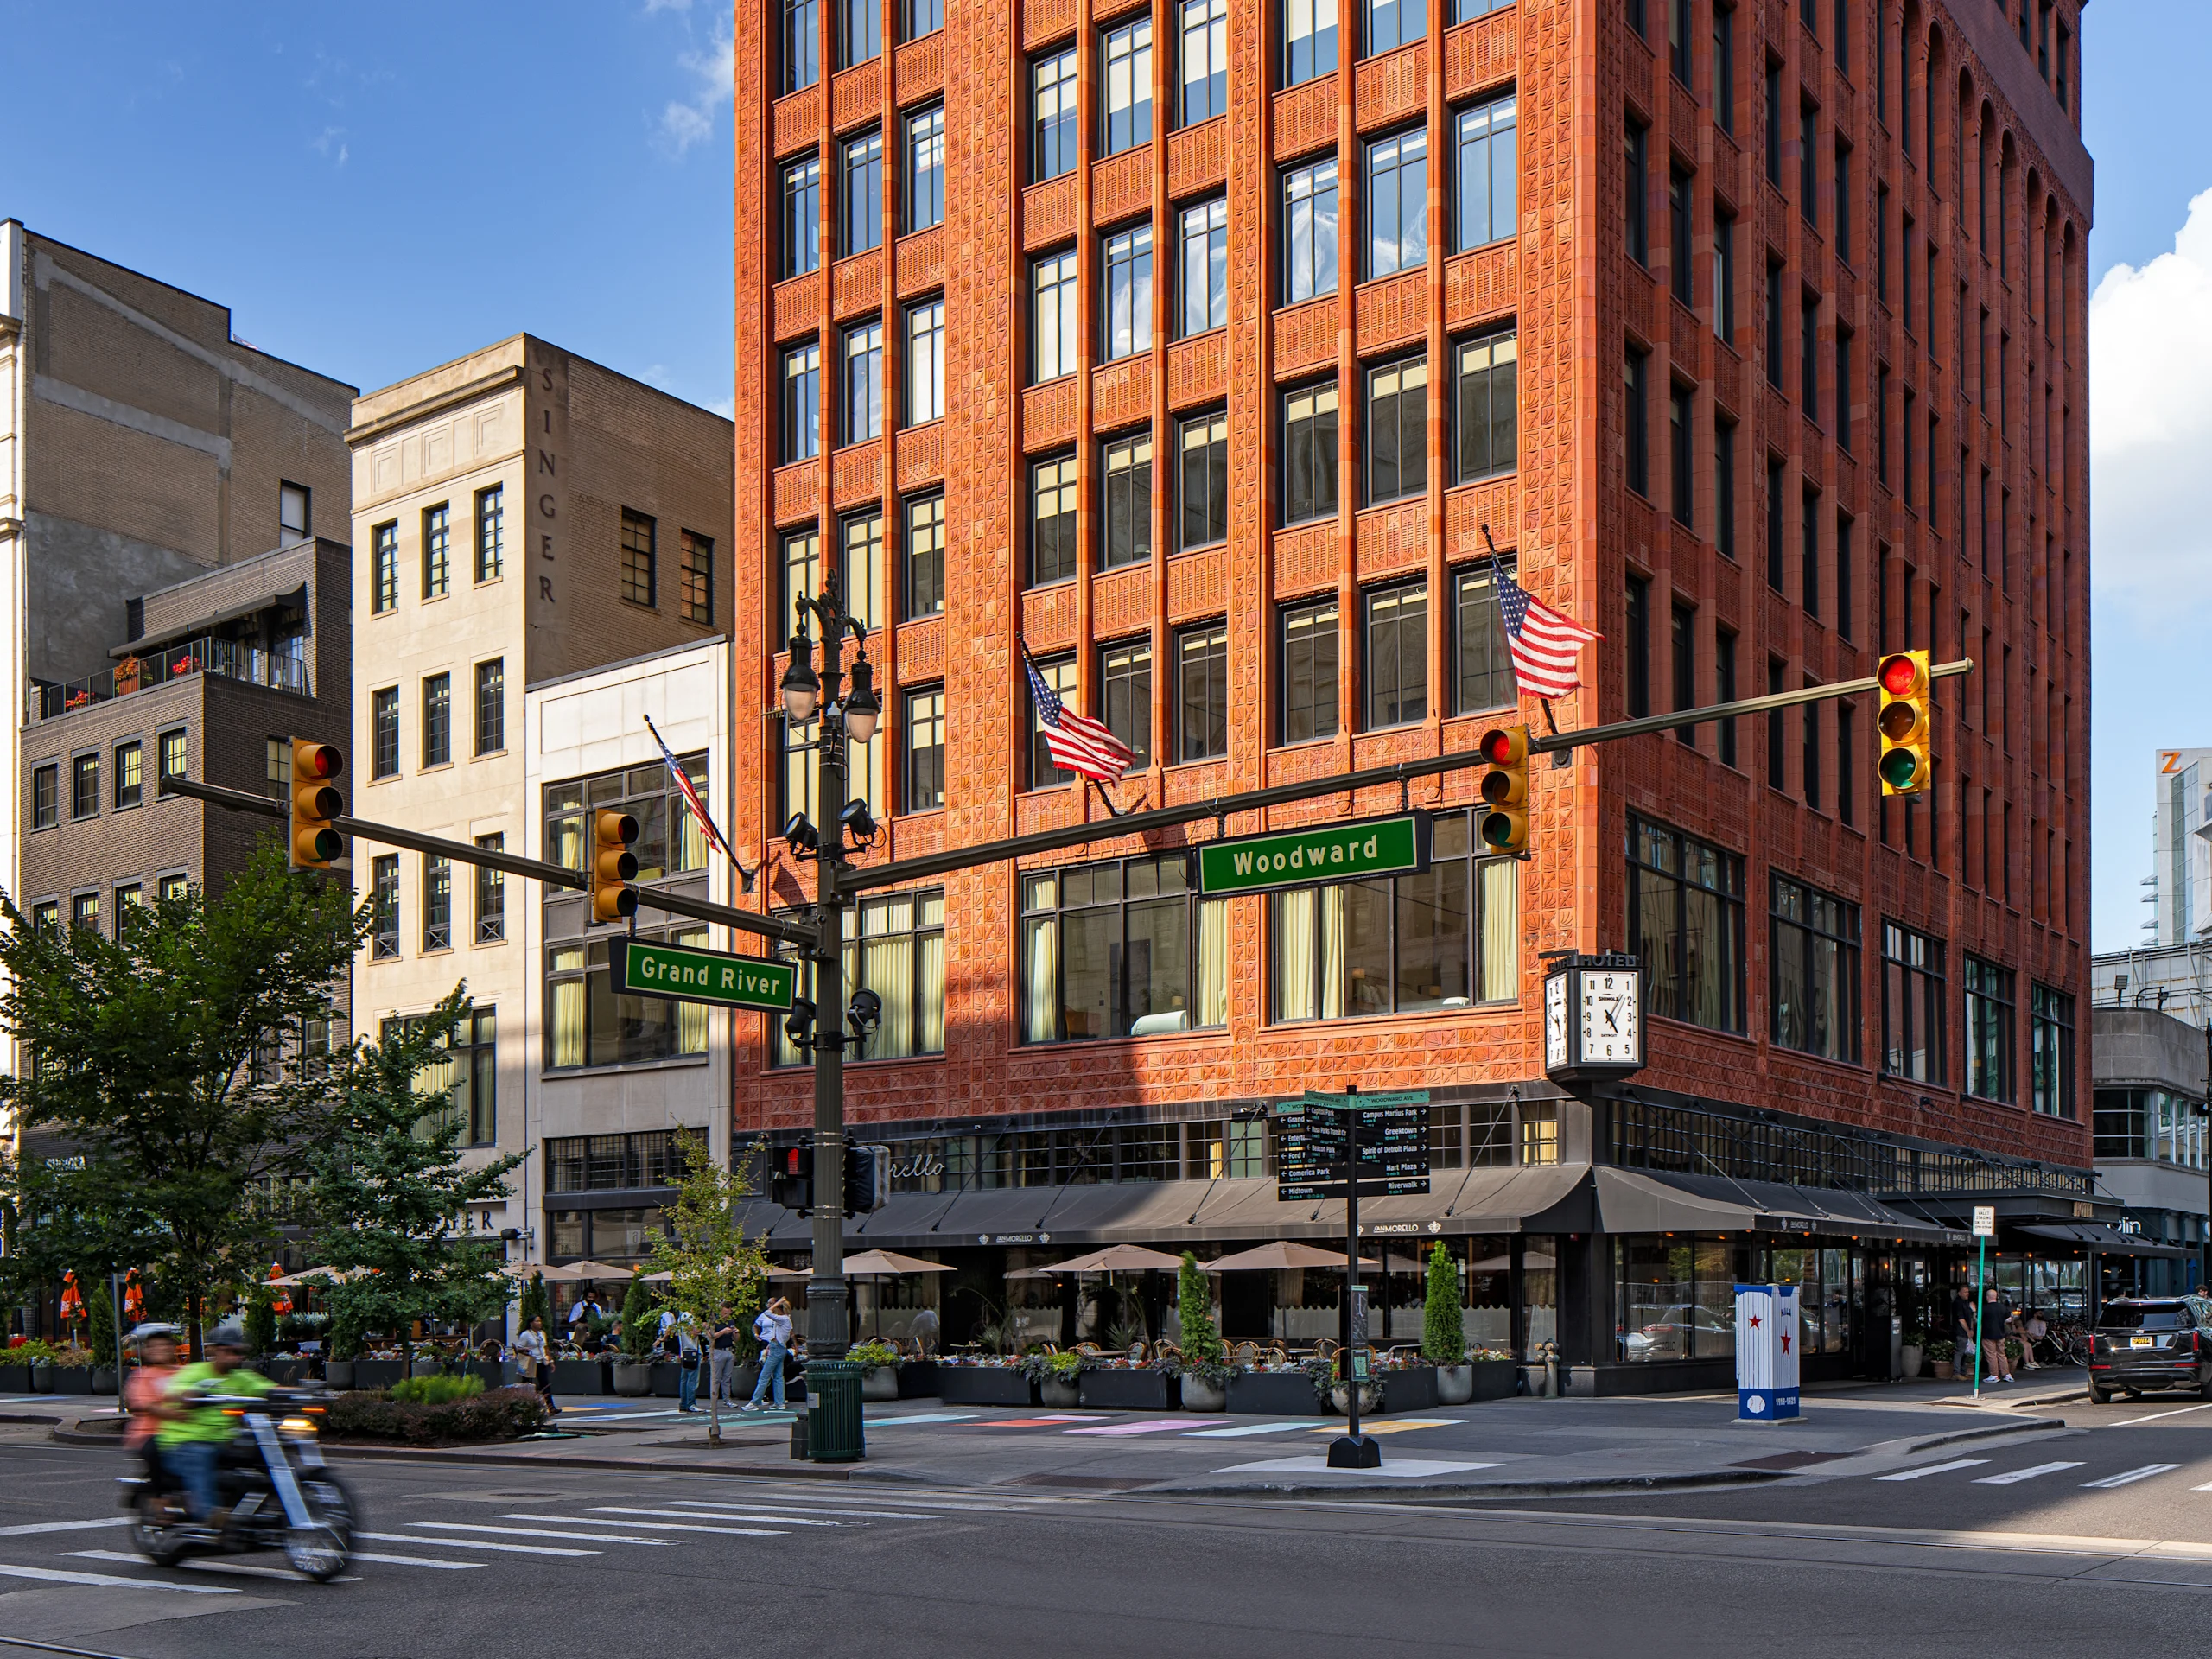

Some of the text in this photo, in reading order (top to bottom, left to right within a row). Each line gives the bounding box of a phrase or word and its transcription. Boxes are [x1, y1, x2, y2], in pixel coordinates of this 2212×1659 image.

[539, 367, 555, 604] SINGER
[2161, 752, 2182, 774] Z
[1233, 834, 1377, 876] Woodward
[1583, 955, 1636, 966] HOTEL
[641, 956, 780, 995] Grand River
[1589, 980, 1595, 990] 11
[1604, 978, 1613, 989] 12
[1626, 980, 1629, 990] 1
[1586, 996, 1593, 1006] 10
[1627, 996, 1632, 1006] 2
[1586, 1012, 1591, 1022] 9
[1627, 1012, 1632, 1022] 3
[1587, 1028, 1591, 1038] 8
[1627, 1028, 1632, 1038] 4
[1590, 1044, 1594, 1054] 7
[1607, 1045, 1612, 1056] 6
[1625, 1044, 1629, 1054] 5
[1311, 1107, 1325, 1115] Capitol
[1362, 1147, 1376, 1155] Spirit
[889, 1153, 945, 1178] rello
[1388, 1181, 1418, 1189] Riverwalk
